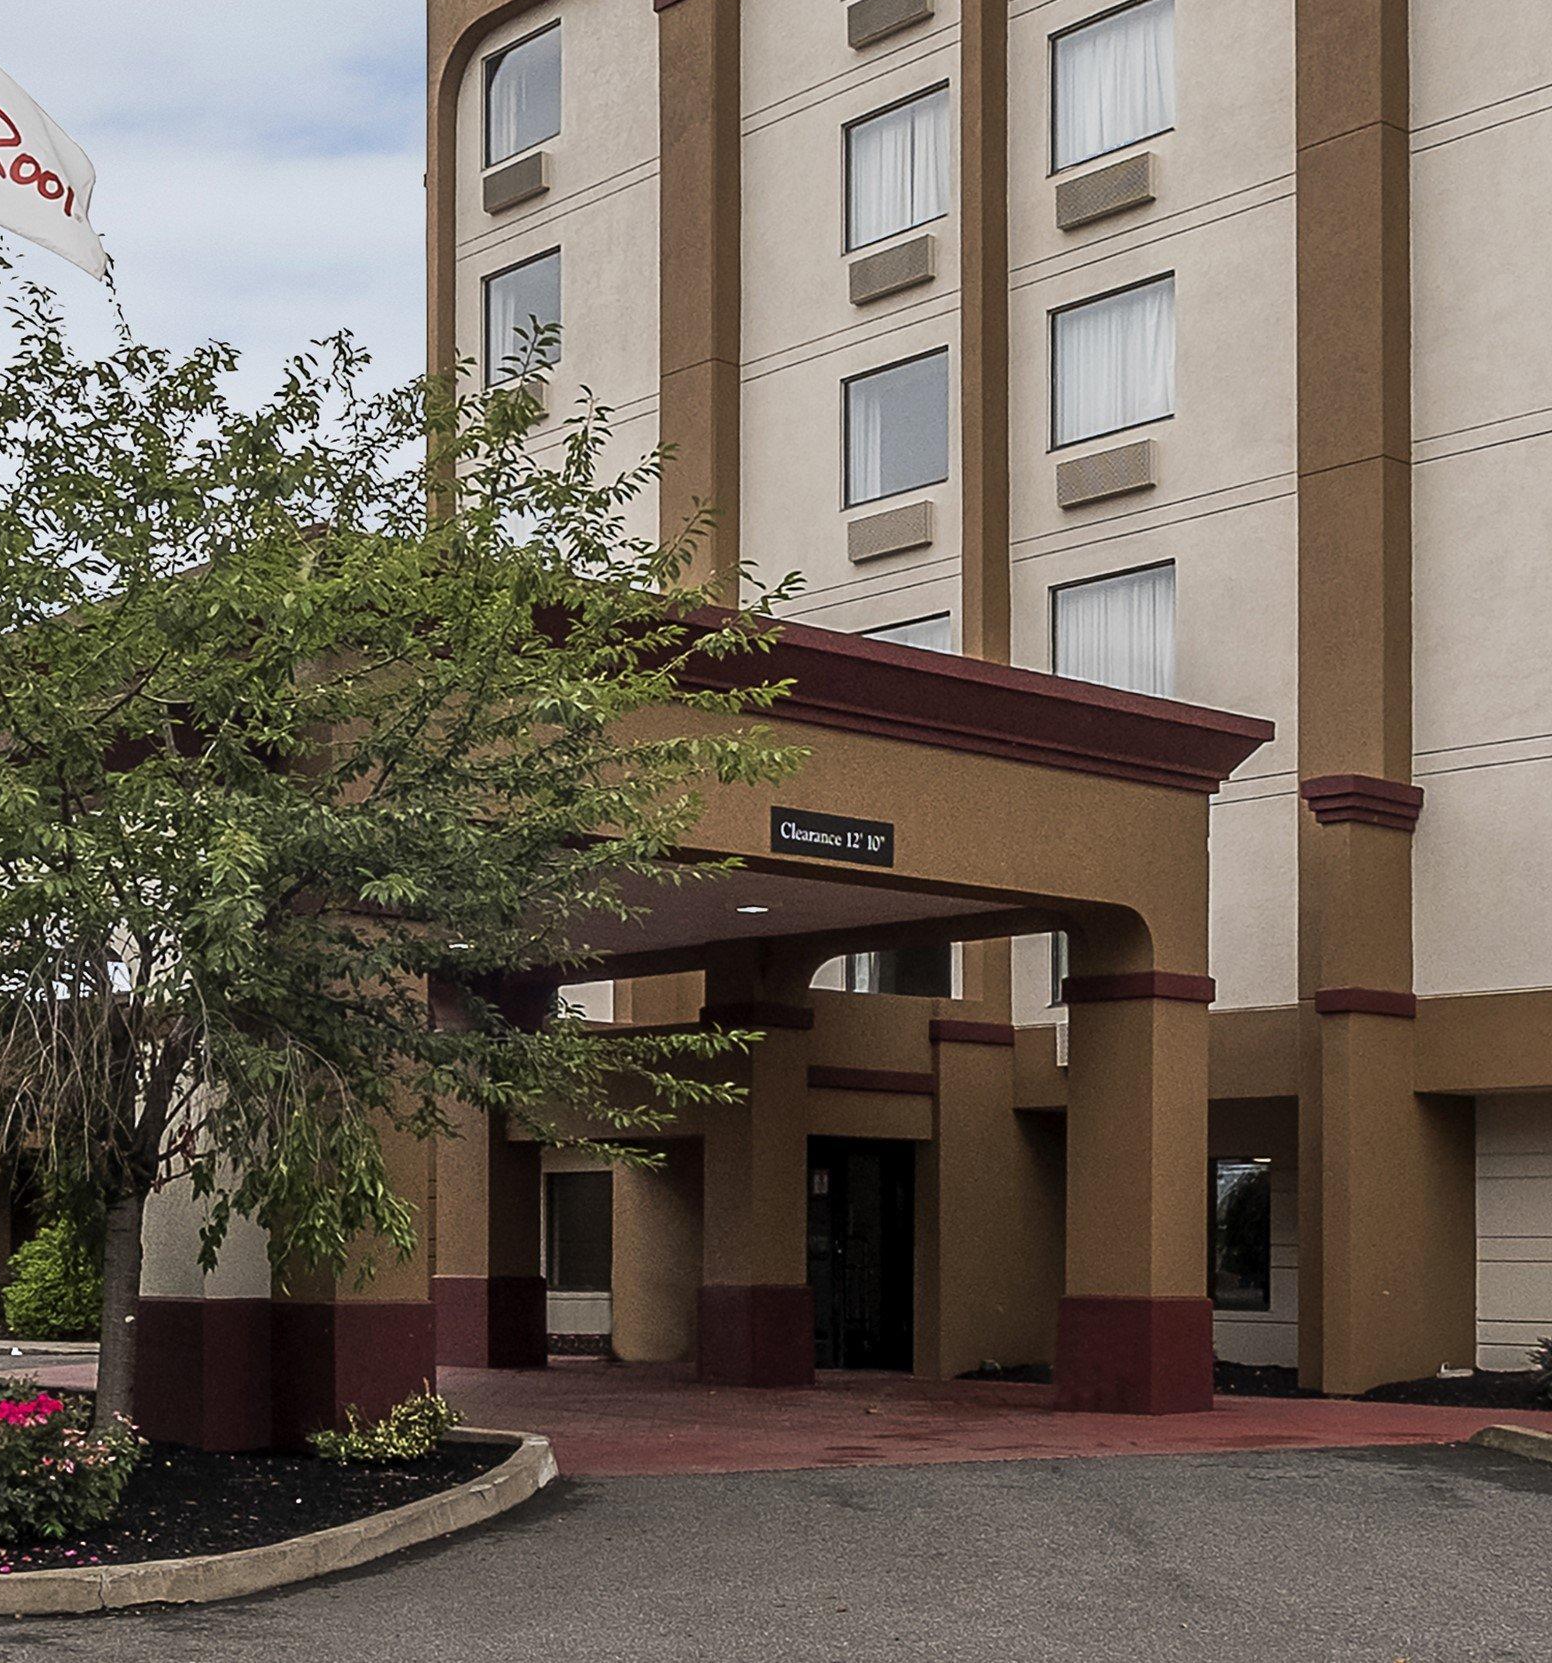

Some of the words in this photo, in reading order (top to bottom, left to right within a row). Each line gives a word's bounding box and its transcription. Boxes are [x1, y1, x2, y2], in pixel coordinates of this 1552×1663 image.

[780, 821, 842, 847] Clearance
[846, 831, 864, 849] 12'
[867, 834, 886, 852] 10"
